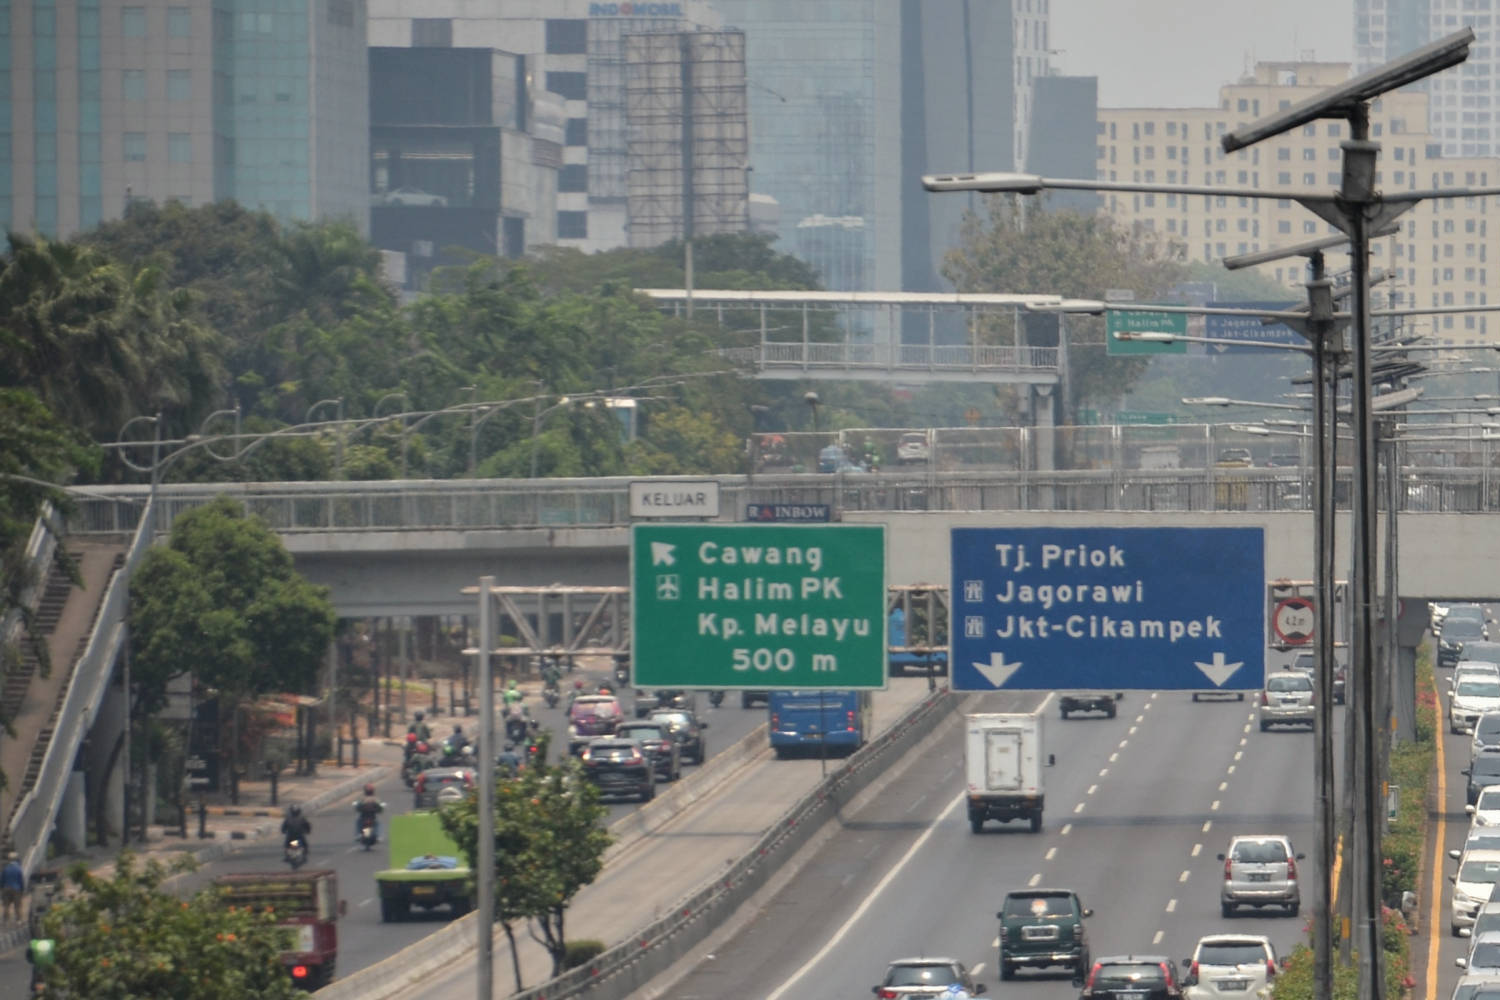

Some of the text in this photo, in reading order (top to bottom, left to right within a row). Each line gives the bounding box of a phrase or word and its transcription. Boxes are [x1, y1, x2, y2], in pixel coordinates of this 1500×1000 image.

[642, 493, 706, 507] KELUAR
[749, 505, 826, 519] RAINBOW
[698, 541, 823, 572] Cawang
[995, 544, 1125, 573] Tj. Priok
[698, 577, 844, 600] Halim PK
[996, 580, 1144, 609] Jagorawi
[698, 613, 870, 641] Kp. Melayu
[996, 615, 1223, 643] Jkt-Cikampek
[732, 648, 838, 672] 500 m
